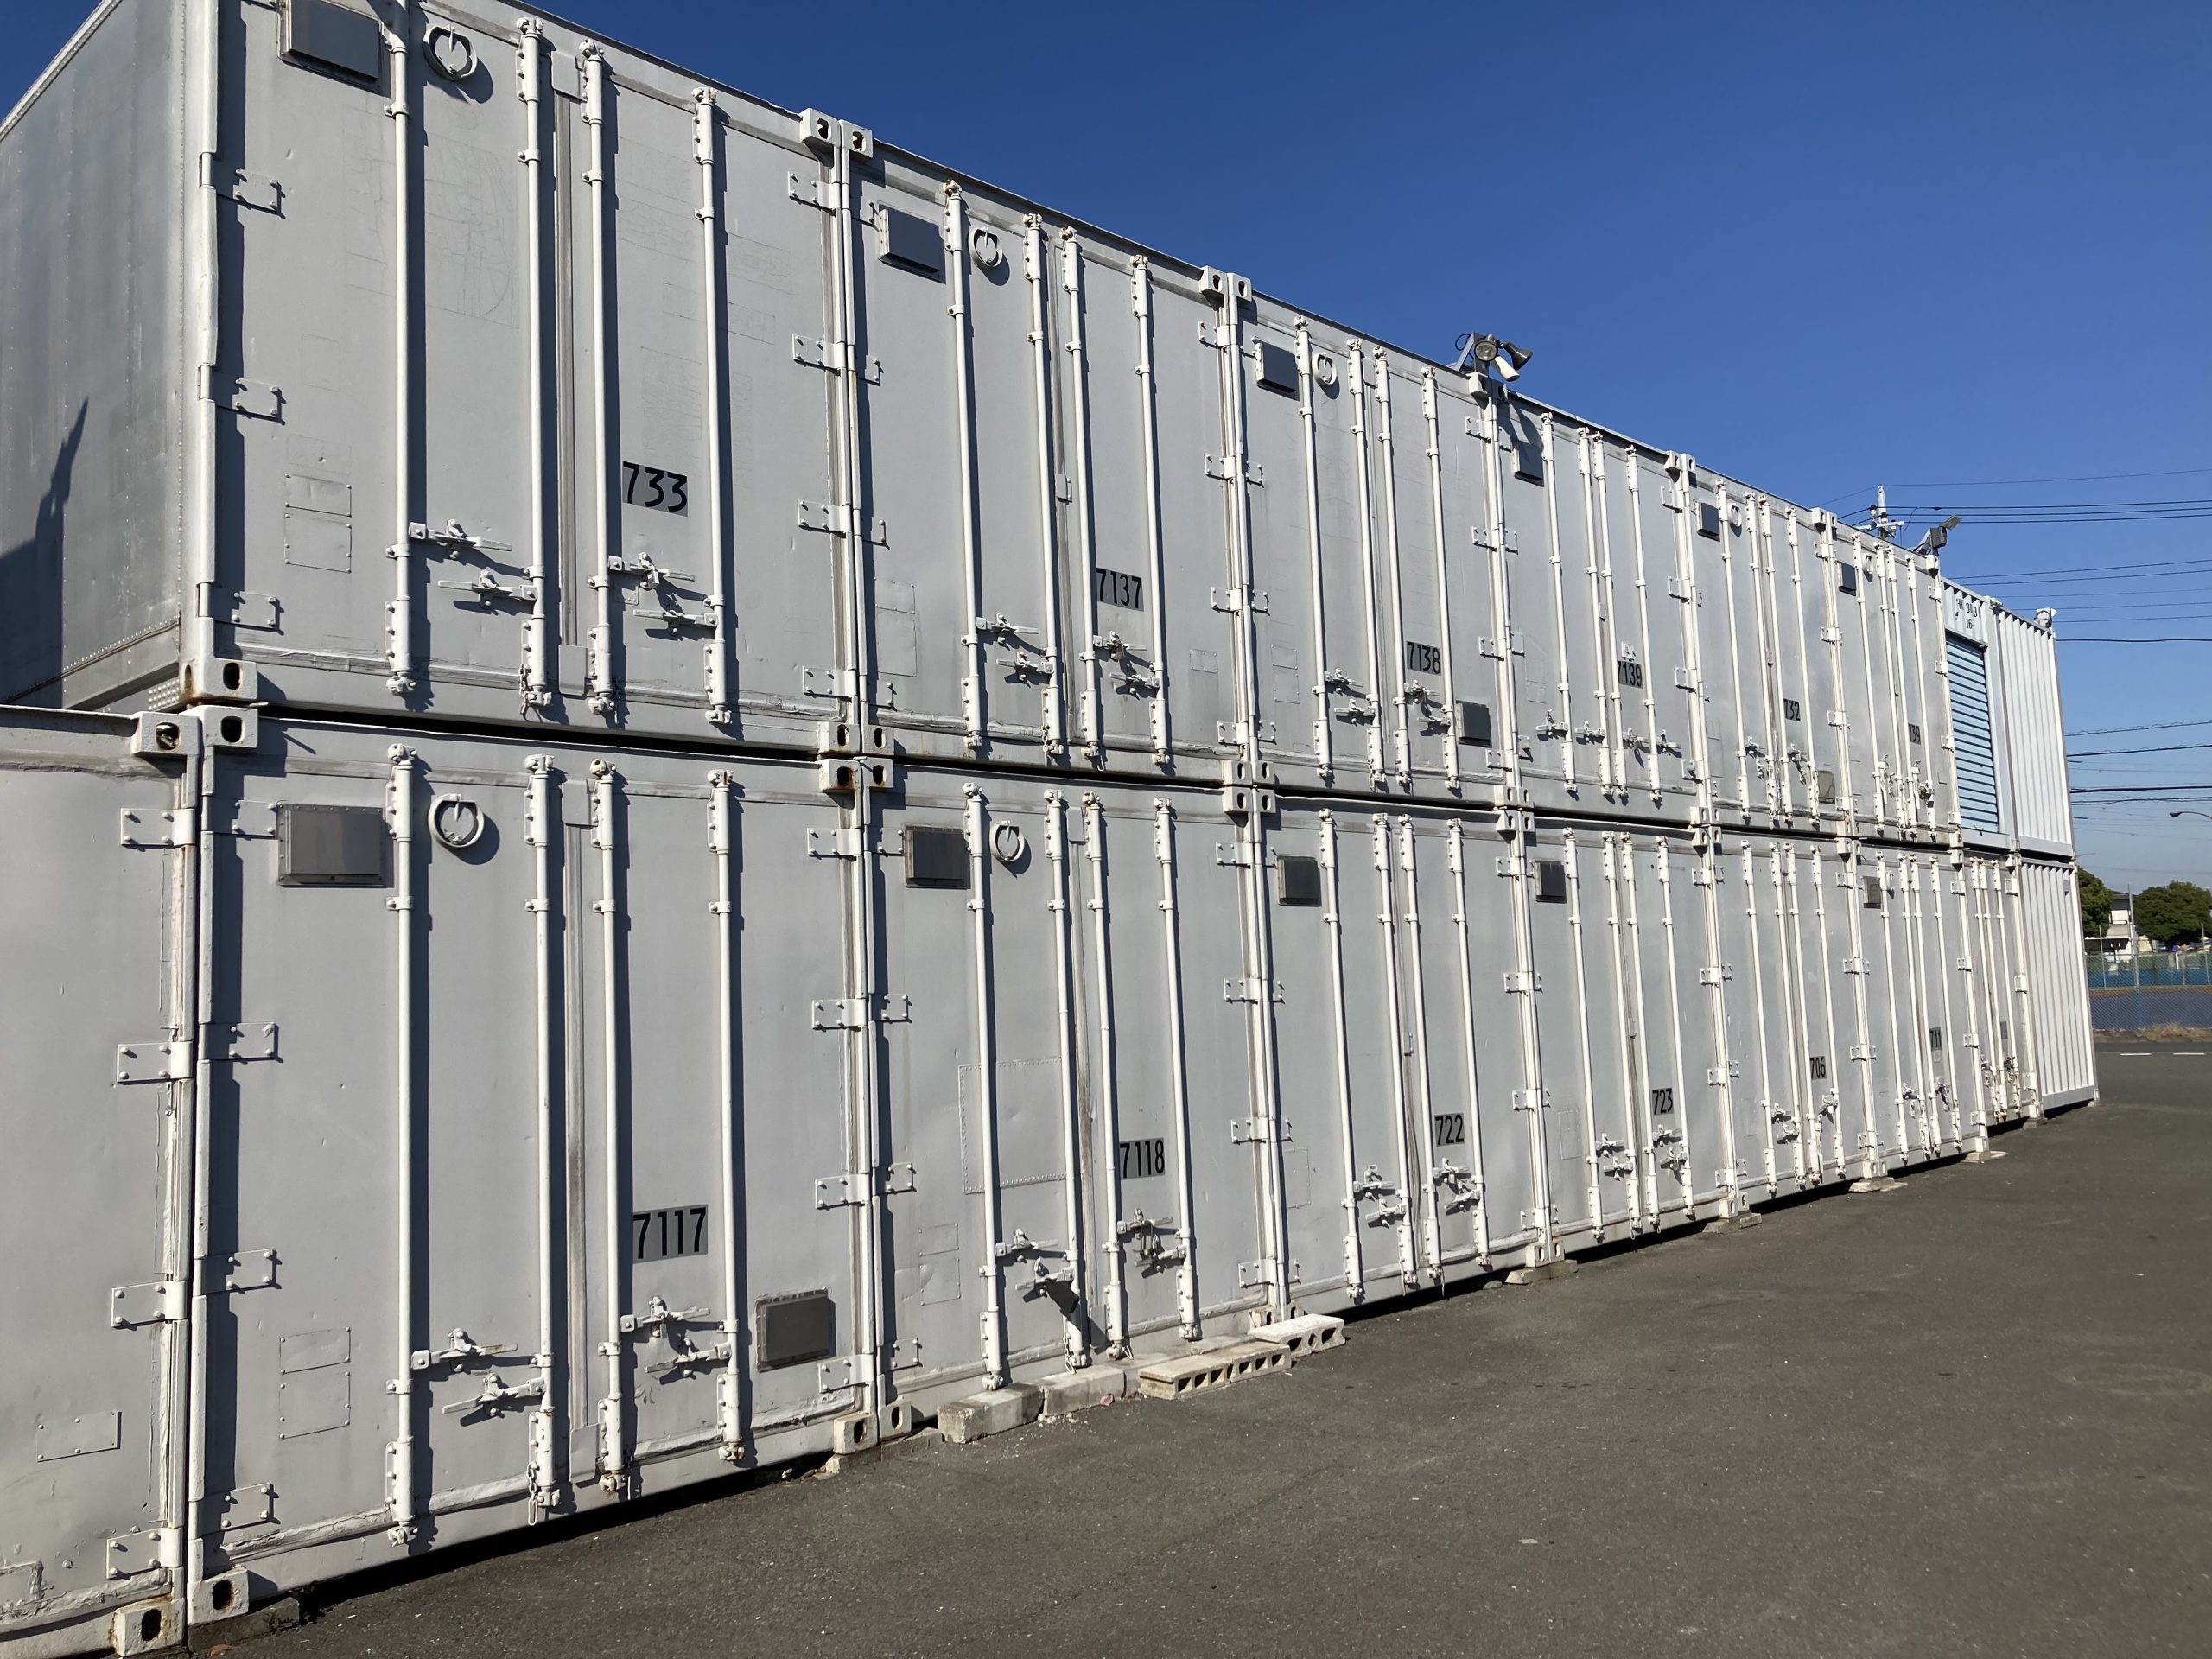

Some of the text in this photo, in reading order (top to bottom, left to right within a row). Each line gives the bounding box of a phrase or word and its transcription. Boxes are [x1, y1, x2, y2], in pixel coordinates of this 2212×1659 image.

[622, 461, 688, 512] 733
[1096, 567, 1143, 609] 7137
[1407, 641, 1441, 675] 7138
[1617, 660, 1643, 688] 7139
[1783, 698, 1801, 721] 732
[1810, 1056, 1826, 1079] 706
[1652, 1088, 1674, 1115] 723
[1434, 1114, 1465, 1146] 722
[1120, 1139, 1165, 1179] 7118
[632, 1207, 707, 1260] 7117
